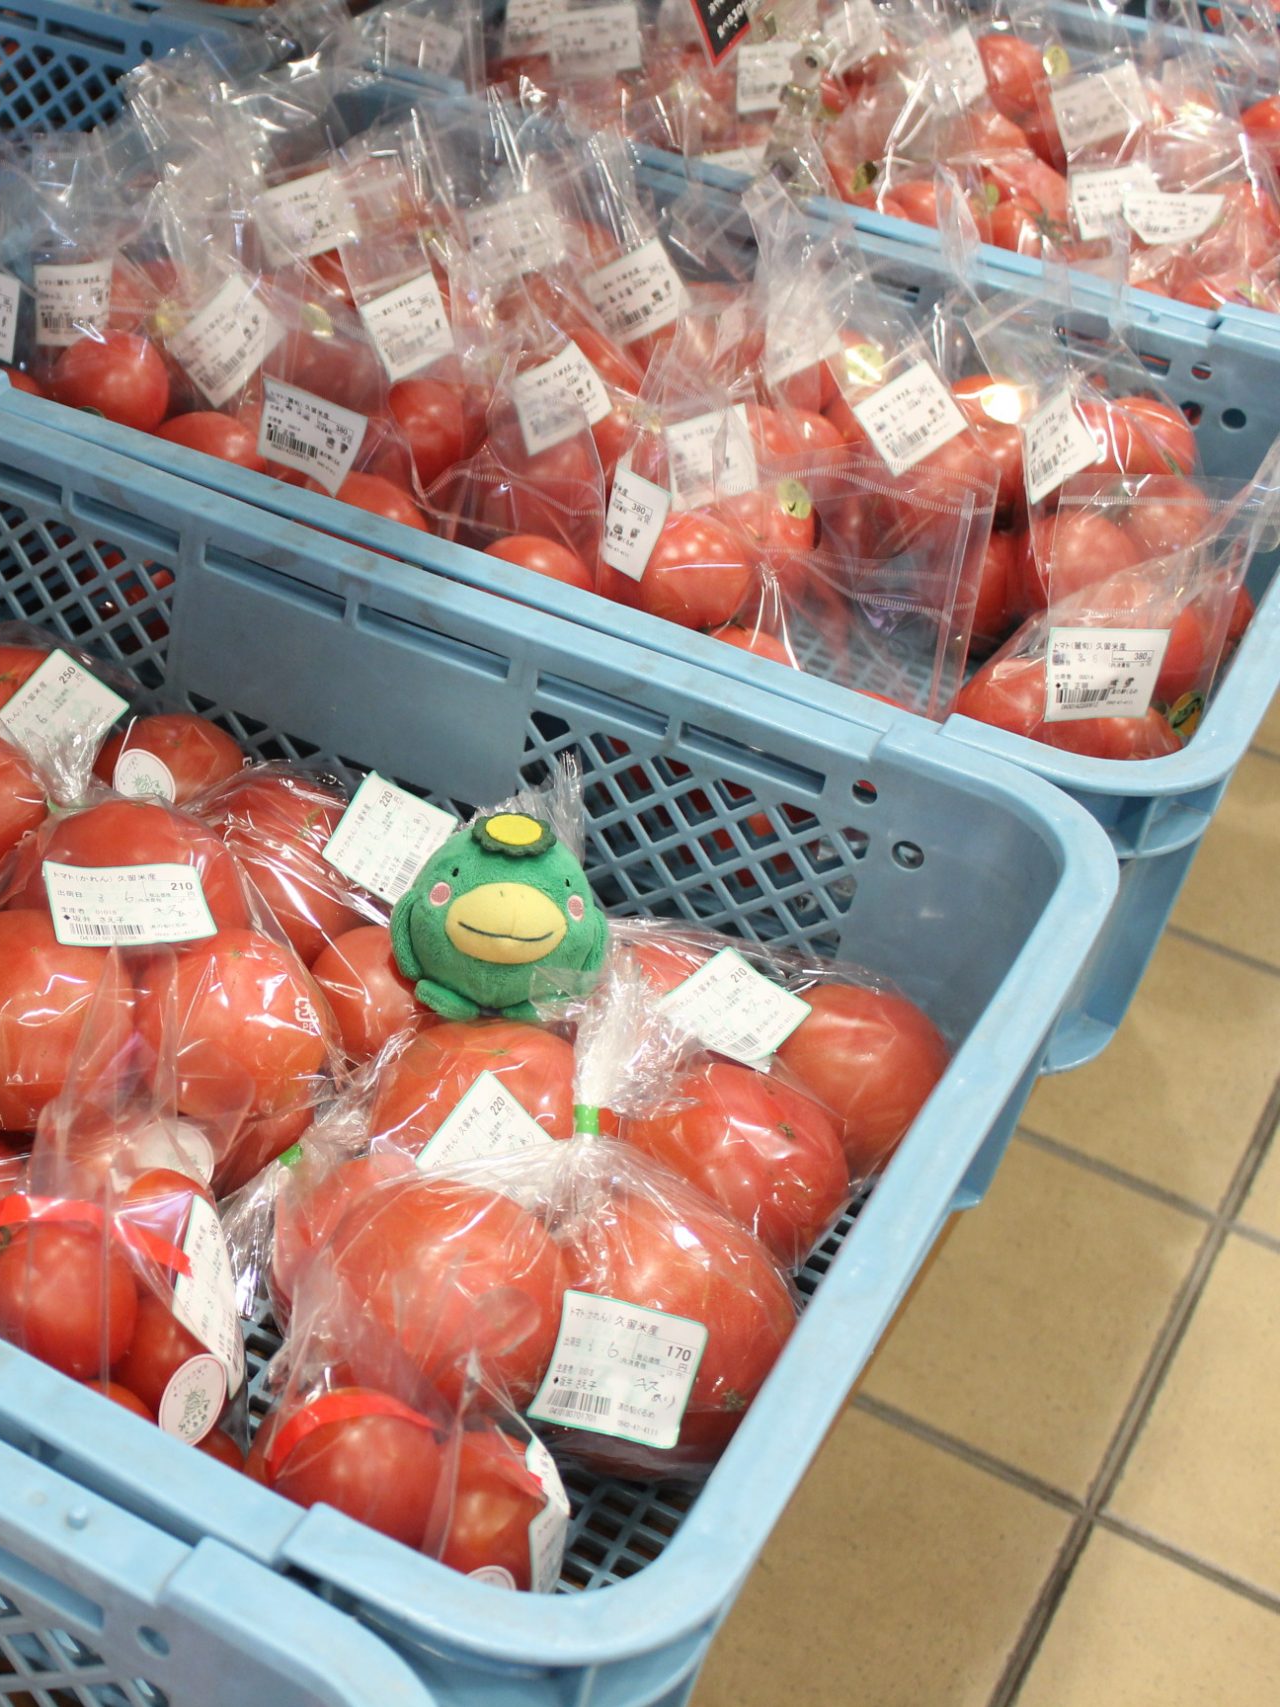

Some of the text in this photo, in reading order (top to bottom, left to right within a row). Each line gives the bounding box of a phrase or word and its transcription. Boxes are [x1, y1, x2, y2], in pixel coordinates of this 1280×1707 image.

[632, 503, 646, 515] 380
[1134, 652, 1147, 660] 380
[59, 665, 76, 684] 250
[379, 791, 393, 808] 220
[118, 873, 156, 882] 久留米産
[170, 882, 193, 891] 210
[730, 968, 747, 983] 210
[490, 1096, 506, 1116] 220
[614, 1317, 659, 1337] 久留米産
[607, 1341, 619, 1358] 6
[666, 1345, 692, 1372] 170 円
